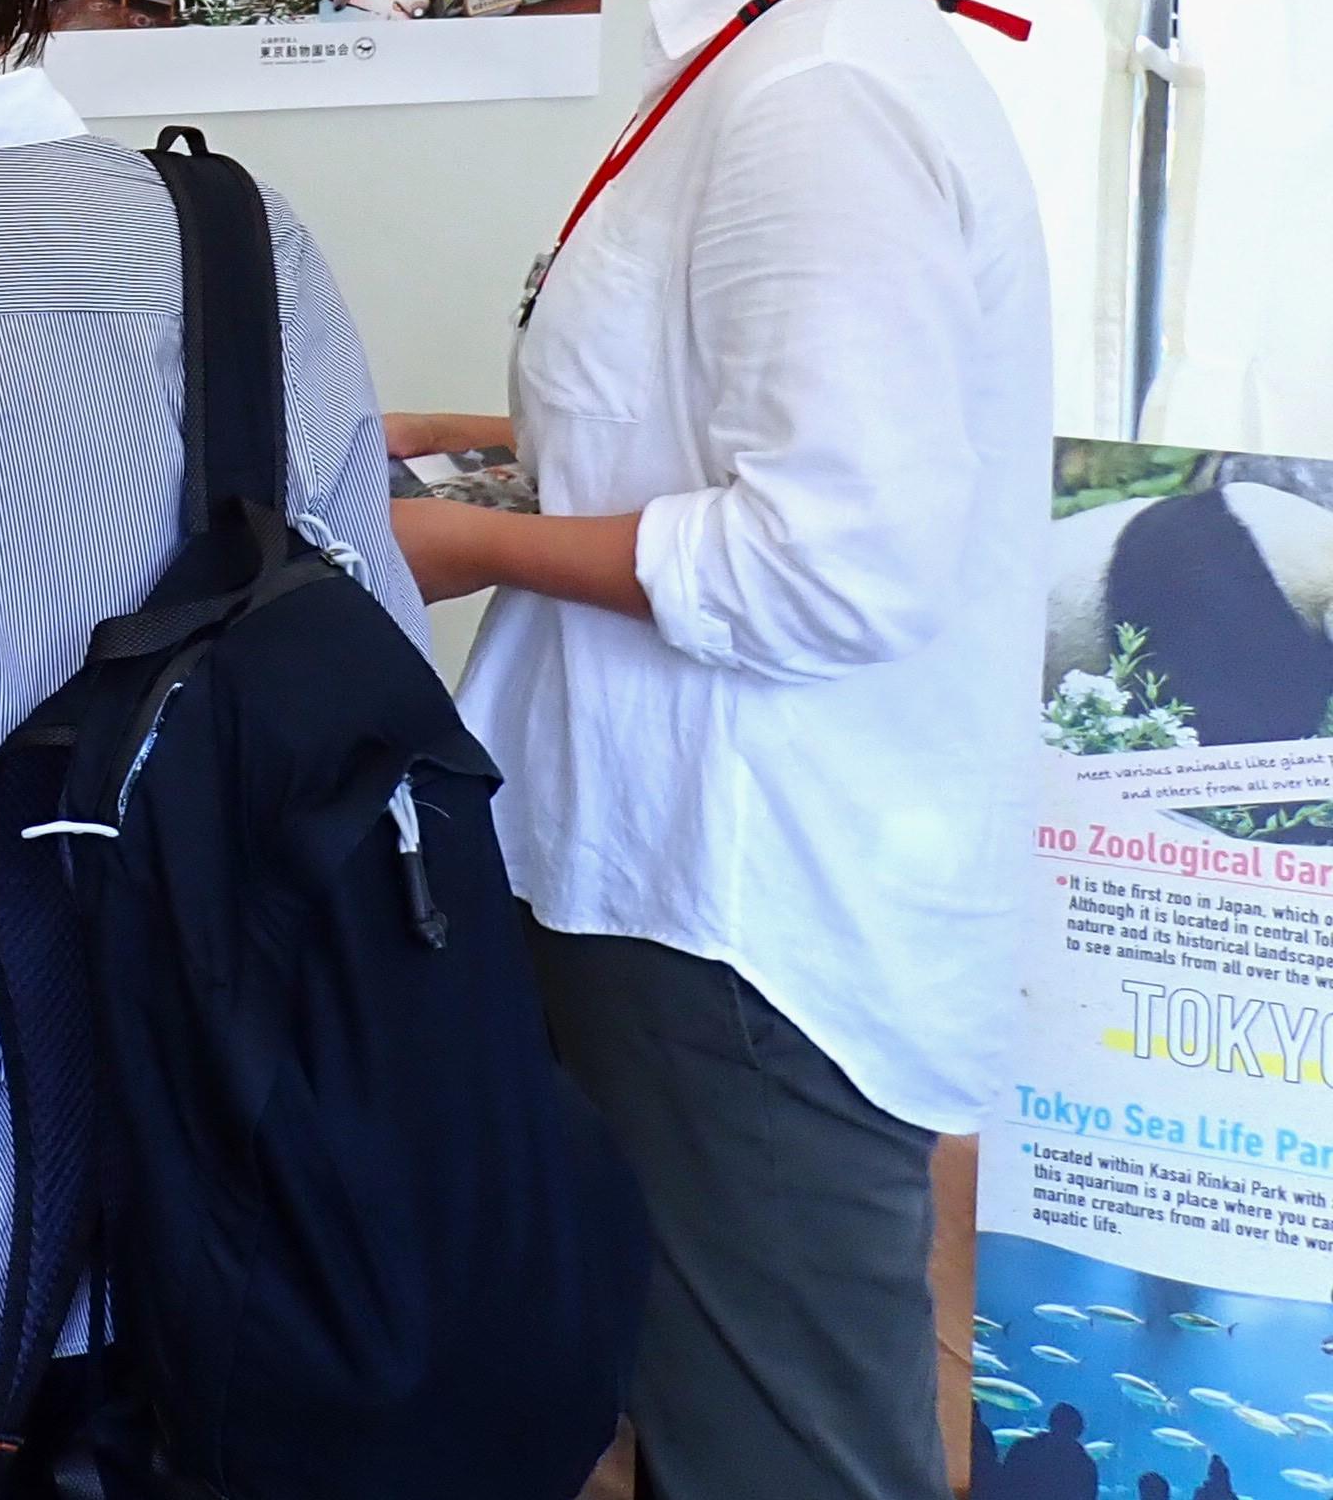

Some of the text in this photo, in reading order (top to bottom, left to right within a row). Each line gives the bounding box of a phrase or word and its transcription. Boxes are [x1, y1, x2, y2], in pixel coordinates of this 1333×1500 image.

[1115, 762, 1173, 778] various
[1177, 758, 1242, 774] animals
[1246, 754, 1277, 769] like
[1281, 753, 1327, 770] giant
[1121, 775, 1331, 800] and others from all over the
[1088, 823, 1333, 887] Zoological Gar
[1068, 894, 1309, 945] Although it is located in central
[1069, 875, 1319, 925] It is the first zoo in which
[1066, 917, 1250, 956] nature and its historical
[1066, 935, 1310, 986] to see animals from all over the
[1015, 1084, 1333, 1170] Tokyo Sea Life Par
[1033, 1141, 1327, 1208] Located within Kasai Rinkai Park with
[1034, 1163, 1306, 1227] this aquarium is a place where you
[1033, 1186, 1300, 1246] marine creatures from all over the
[1033, 1207, 1123, 1235] aquatic life.
